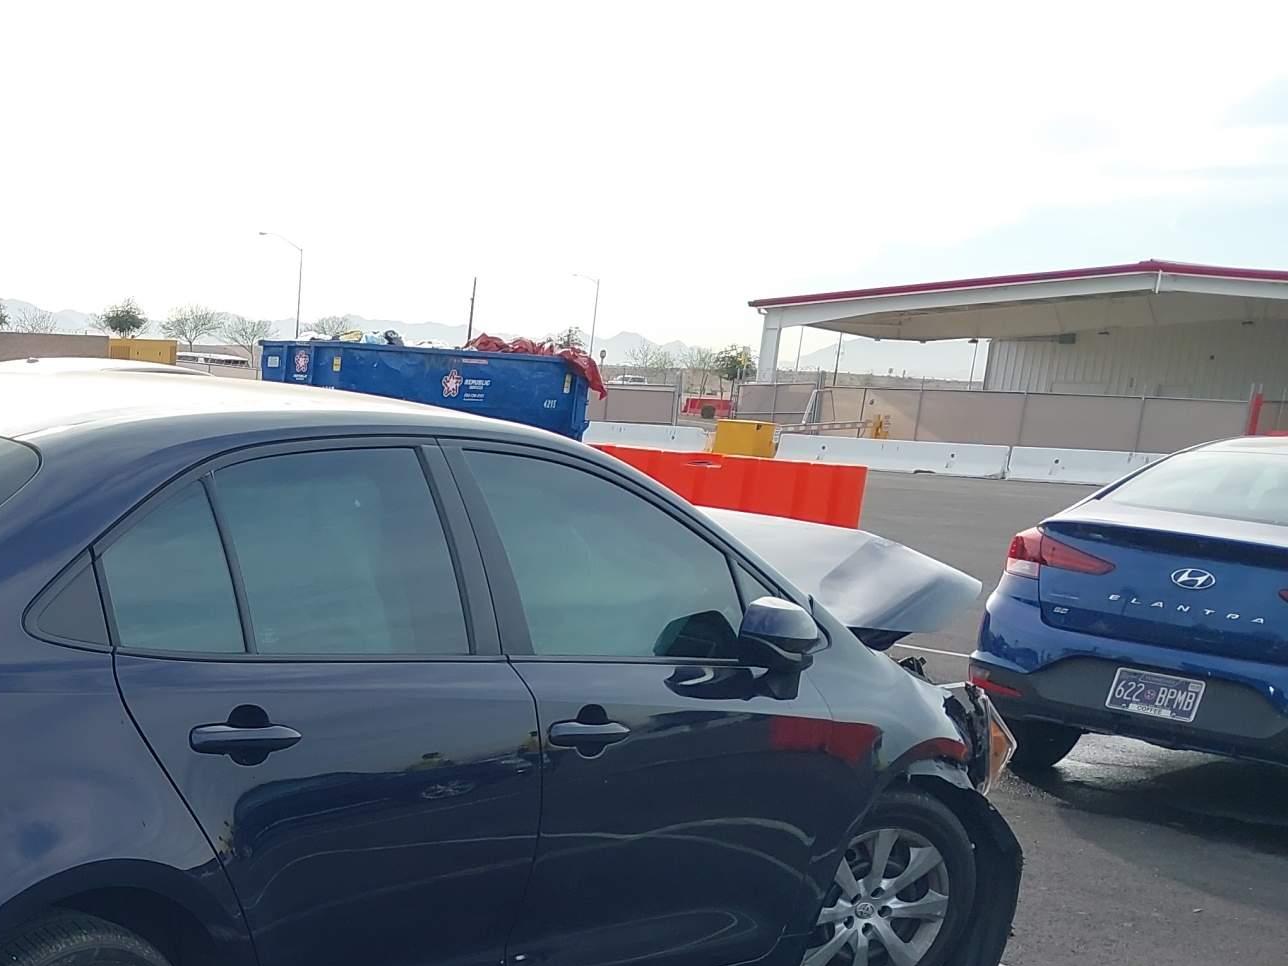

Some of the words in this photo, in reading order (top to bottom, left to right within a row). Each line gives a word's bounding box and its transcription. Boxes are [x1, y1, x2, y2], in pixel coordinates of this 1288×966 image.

[1108, 593, 1265, 624] ELANTRA
[1114, 680, 1145, 702] 622
[1155, 687, 1196, 711] BPMB
